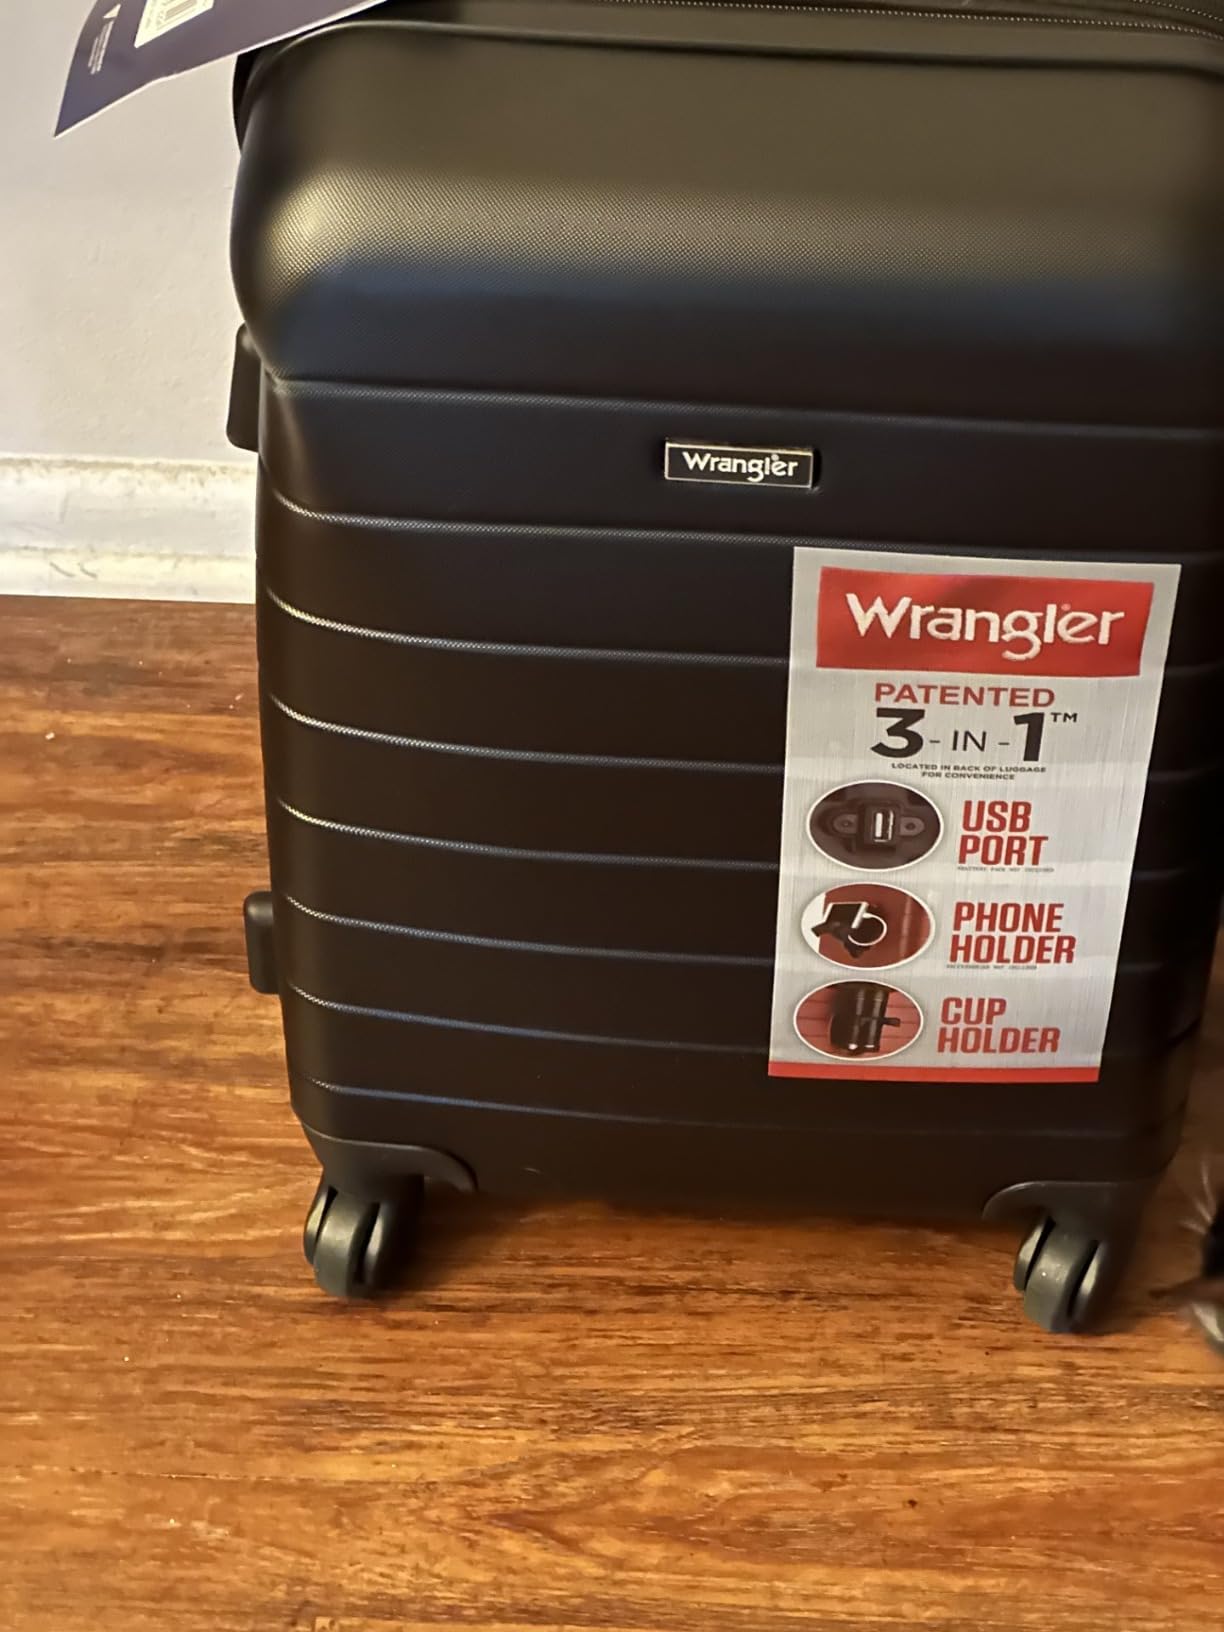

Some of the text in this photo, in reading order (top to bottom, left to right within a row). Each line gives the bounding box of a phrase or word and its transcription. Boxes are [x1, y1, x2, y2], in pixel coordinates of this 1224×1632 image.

[682, 451, 798, 482] Wrangler
[846, 593, 1125, 661] Wrangler
[874, 682, 1055, 708] PATENTED
[891, 762, 938, 771] LOCATED
[999, 766, 1047, 774] LUGGAGE
[944, 772, 1016, 780] CONVENIENCE
[962, 800, 1032, 833] USB
[957, 835, 1049, 866] PORT
[952, 901, 1064, 933] PHONE
[948, 934, 1077, 964] HOLDER
[940, 996, 1007, 1025] CUP
[936, 1027, 1061, 1054] HOLDER
